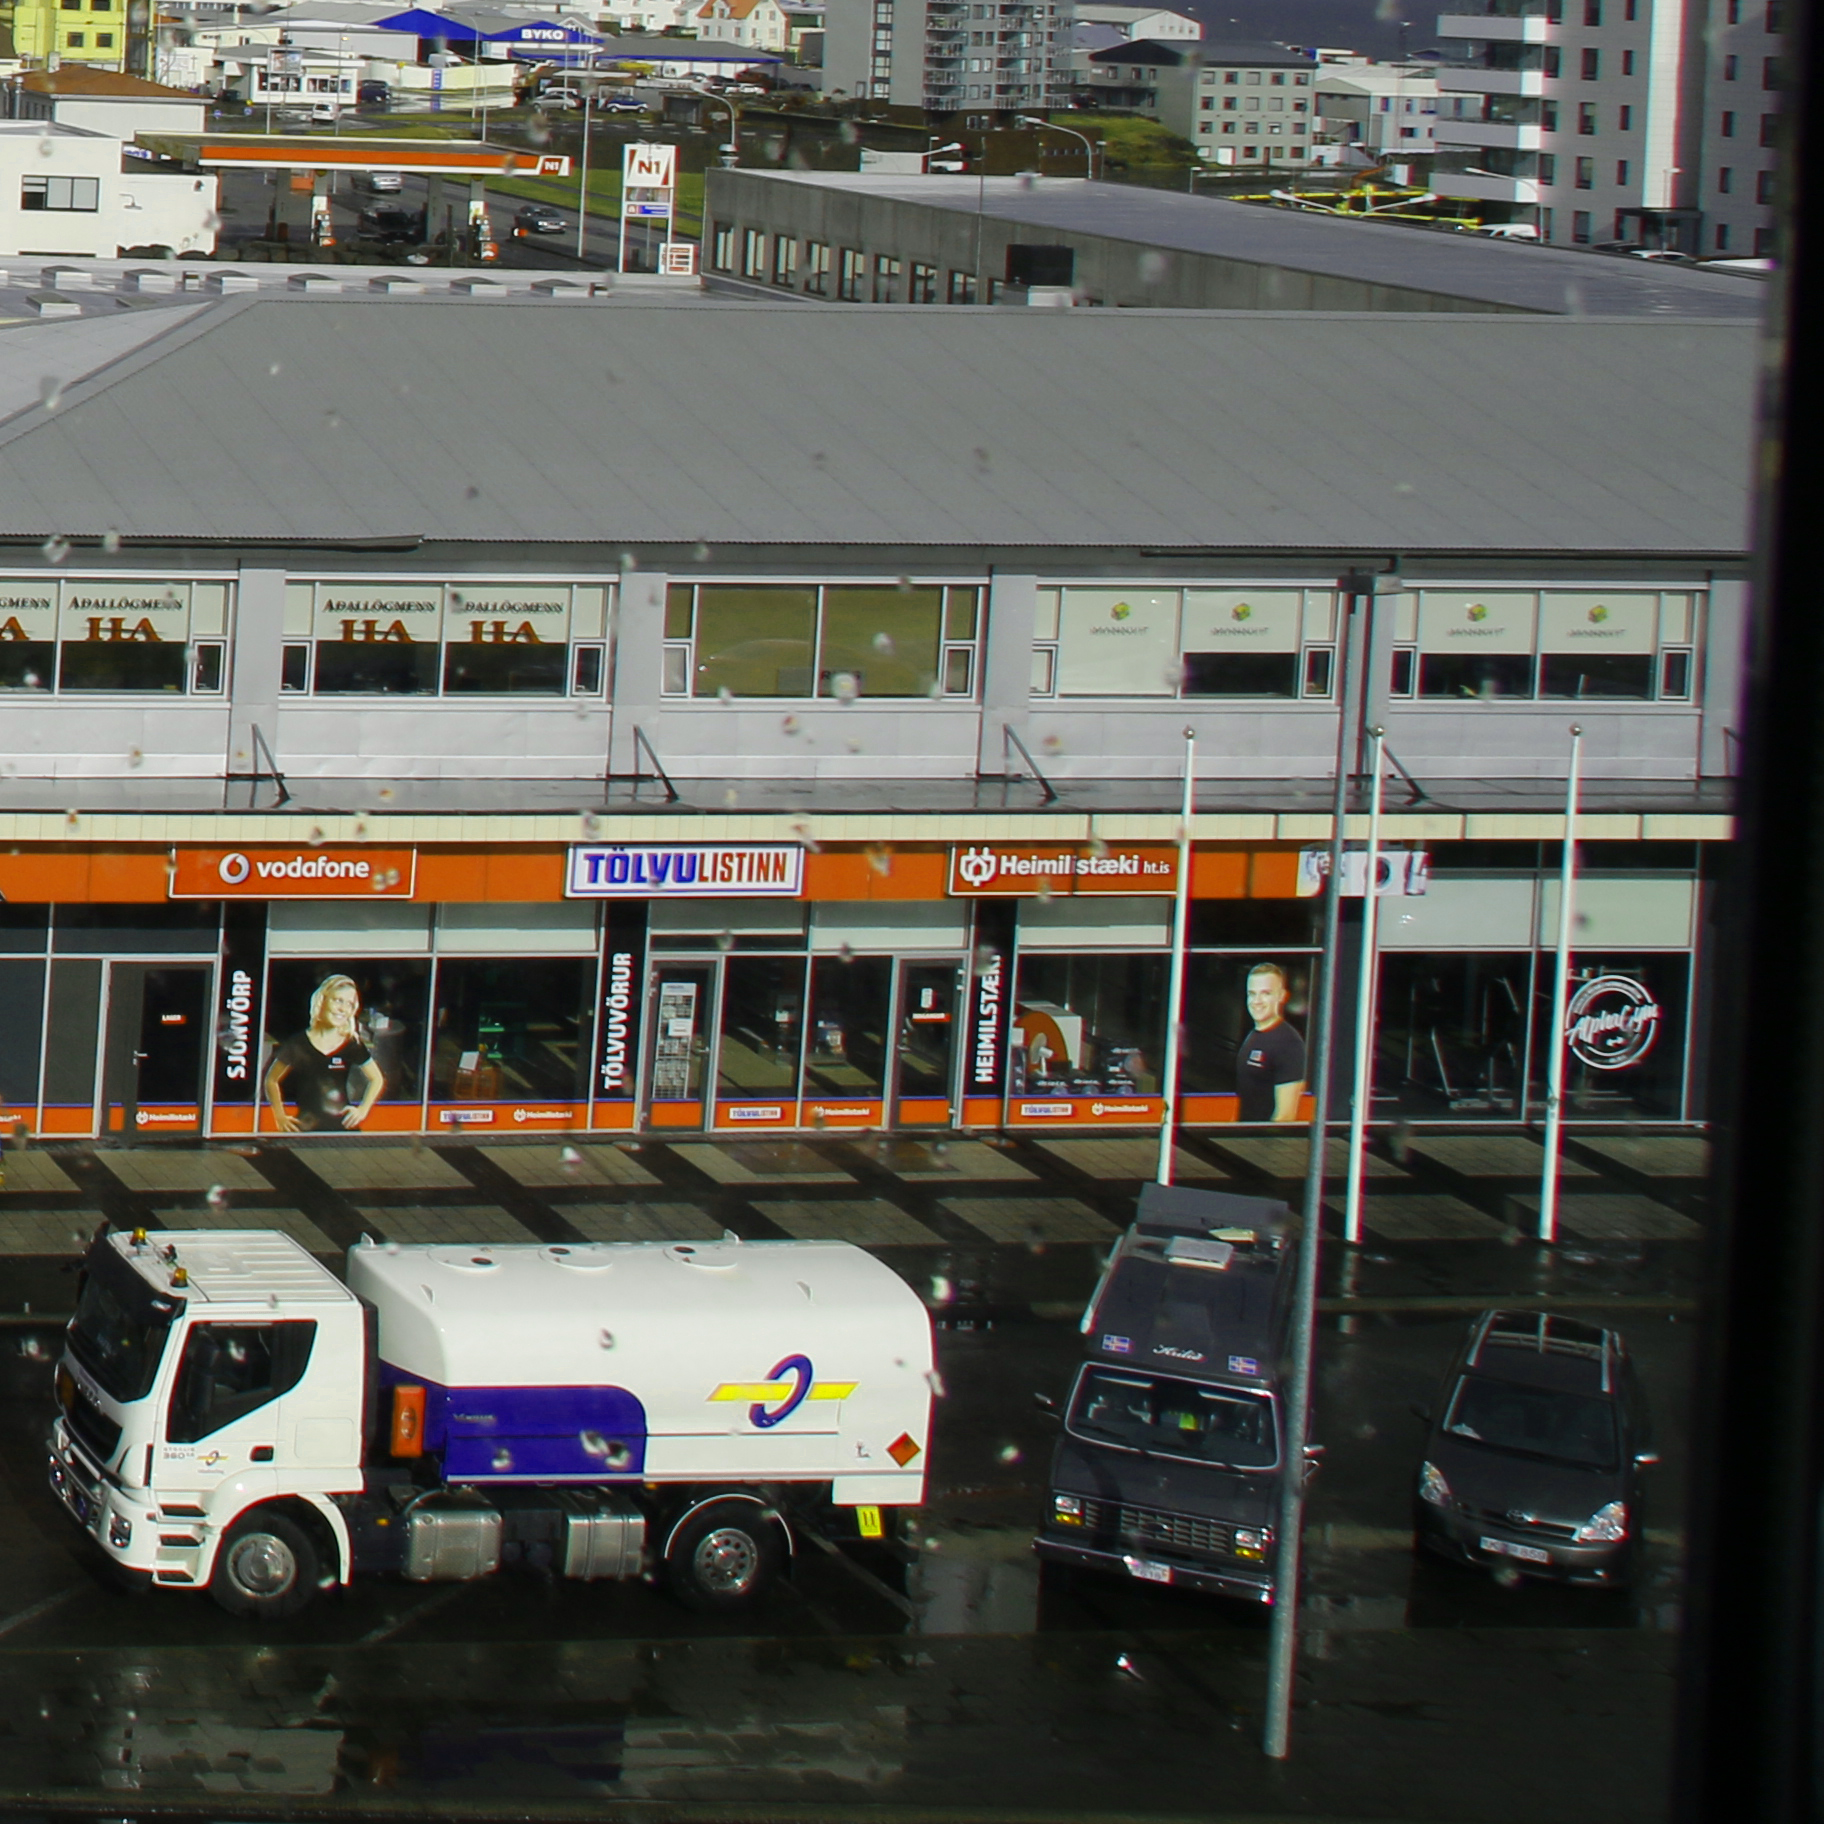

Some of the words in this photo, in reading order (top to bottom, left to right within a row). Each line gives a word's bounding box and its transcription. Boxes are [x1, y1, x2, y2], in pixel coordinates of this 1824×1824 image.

[521, 29, 564, 40] BYKO
[544, 160, 560, 171] N1
[638, 160, 661, 174] N1
[256, 856, 370, 878] vodafone
[583, 847, 788, 884] TÖLVULISTINN
[1143, 860, 1170, 875] ht.is
[601, 953, 632, 1090] TÖLVUVÖRUR
